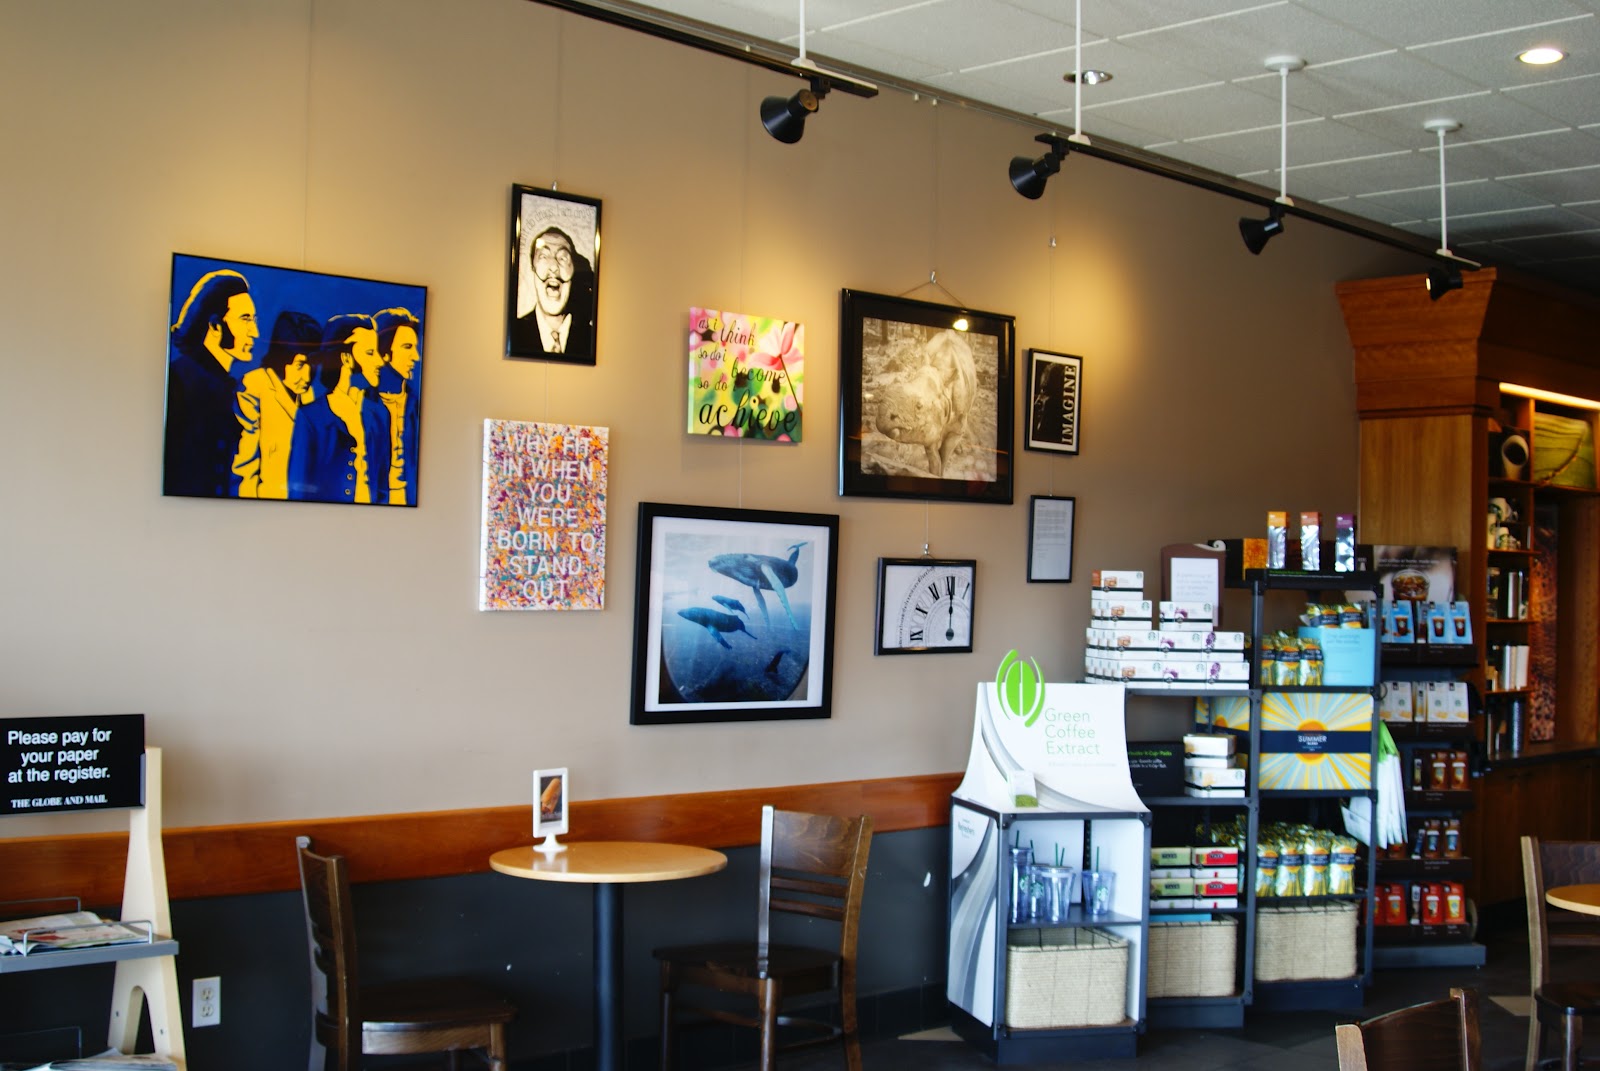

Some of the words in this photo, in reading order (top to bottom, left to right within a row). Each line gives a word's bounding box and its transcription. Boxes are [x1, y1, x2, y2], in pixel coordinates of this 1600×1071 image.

[698, 318, 709, 329] as
[713, 318, 718, 330] i
[720, 320, 756, 346] think
[698, 347, 708, 359] so
[710, 346, 722, 361] do
[731, 356, 786, 384] become
[698, 378, 709, 389] so
[715, 373, 727, 391] do
[698, 388, 798, 432] achieve
[1061, 365, 1076, 446] IMAGINE
[506, 433, 551, 453] WHY
[563, 435, 591, 456] FIT
[503, 458, 523, 477] IN
[531, 459, 594, 481] WHEN
[528, 483, 570, 503] YOU
[516, 506, 578, 527] WERE
[498, 529, 557, 551] BORN
[569, 532, 595, 553] TO
[509, 555, 582, 576] STAND
[523, 579, 569, 600] OUT
[1044, 708, 1090, 722] Green
[8, 730, 58, 745] Please
[62, 730, 89, 746] pay
[92, 727, 112, 742] for
[1045, 724, 1096, 739] Coffee
[1046, 740, 1101, 755] Extract
[21, 750, 54, 767] your
[57, 749, 99, 765] paper
[8, 769, 23, 783] at
[26, 768, 50, 782] the
[54, 766, 111, 783] register.
[11, 799, 31, 808] THE
[32, 797, 63, 807] GLOBE
[64, 795, 84, 805] AND
[85, 794, 108, 804] MAIL
